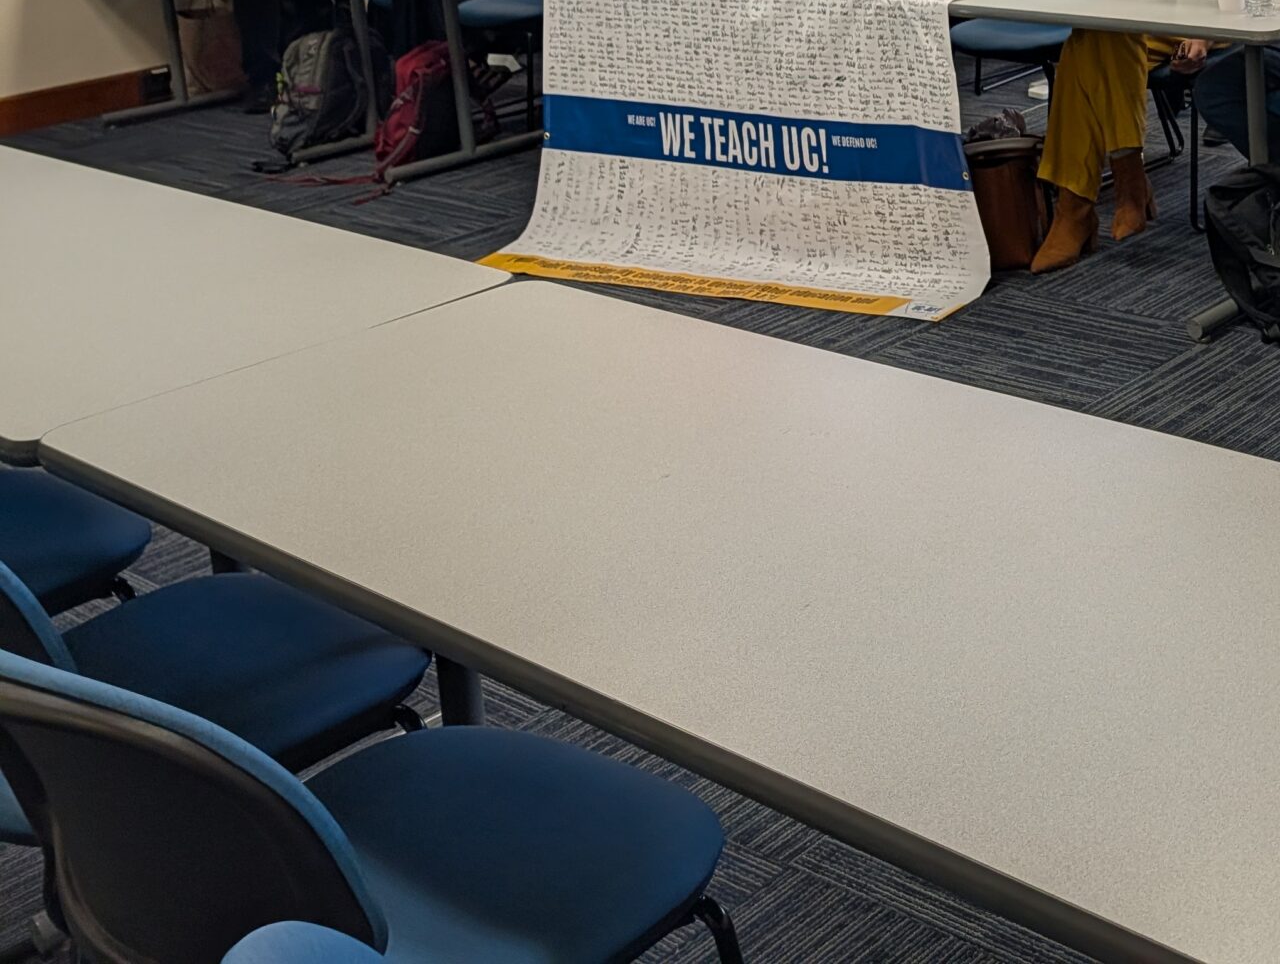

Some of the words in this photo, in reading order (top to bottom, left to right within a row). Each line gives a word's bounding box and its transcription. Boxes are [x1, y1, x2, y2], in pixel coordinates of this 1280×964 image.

[659, 111, 696, 159] WE
[700, 116, 776, 168] TEACH
[782, 125, 829, 174] UC!
[832, 135, 841, 146] WE
[841, 137, 865, 149] DEFEND
